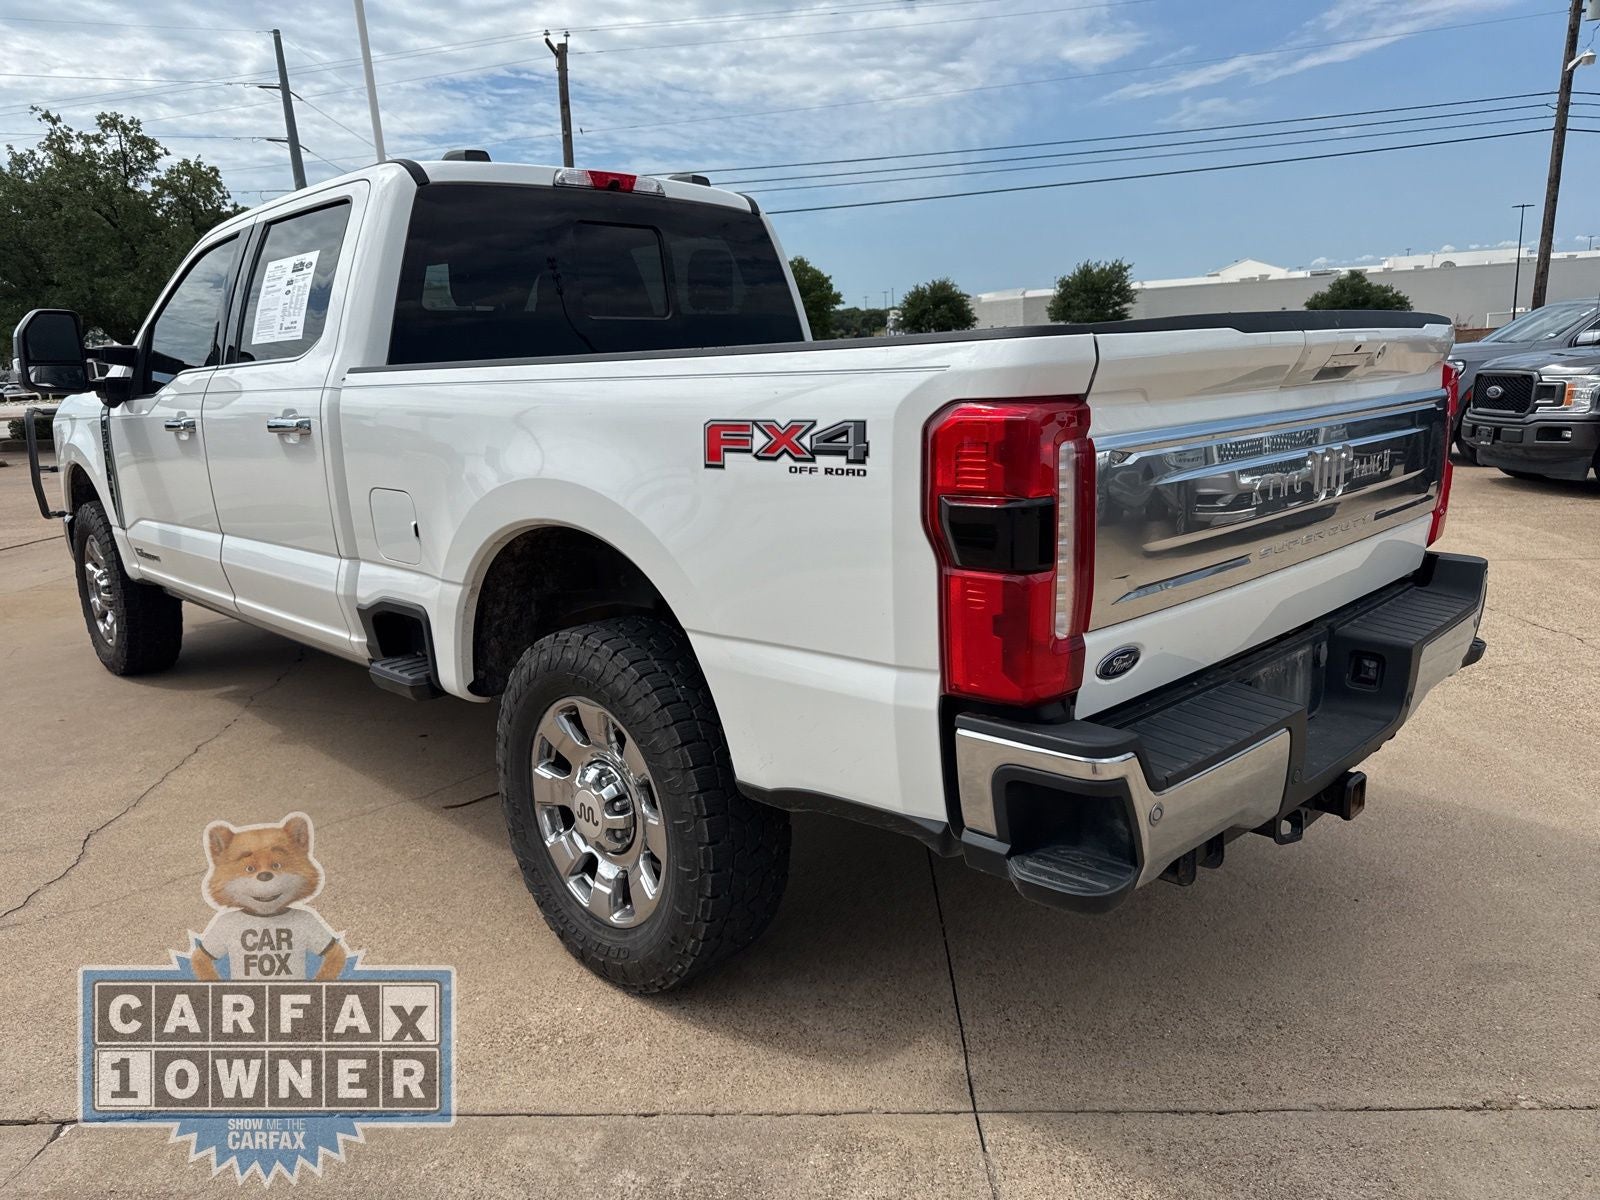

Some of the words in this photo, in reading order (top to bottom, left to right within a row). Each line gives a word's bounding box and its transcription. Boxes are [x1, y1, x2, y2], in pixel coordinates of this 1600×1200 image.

[704, 419, 869, 469] FX4
[789, 465, 818, 475] OFF
[824, 467, 867, 477] ROAD
[1251, 474, 1302, 505] KING
[1352, 448, 1391, 479] RANCH
[1259, 531, 1325, 559] SUPER
[1329, 514, 1370, 536] DUTY
[1109, 654, 1134, 674] Ford
